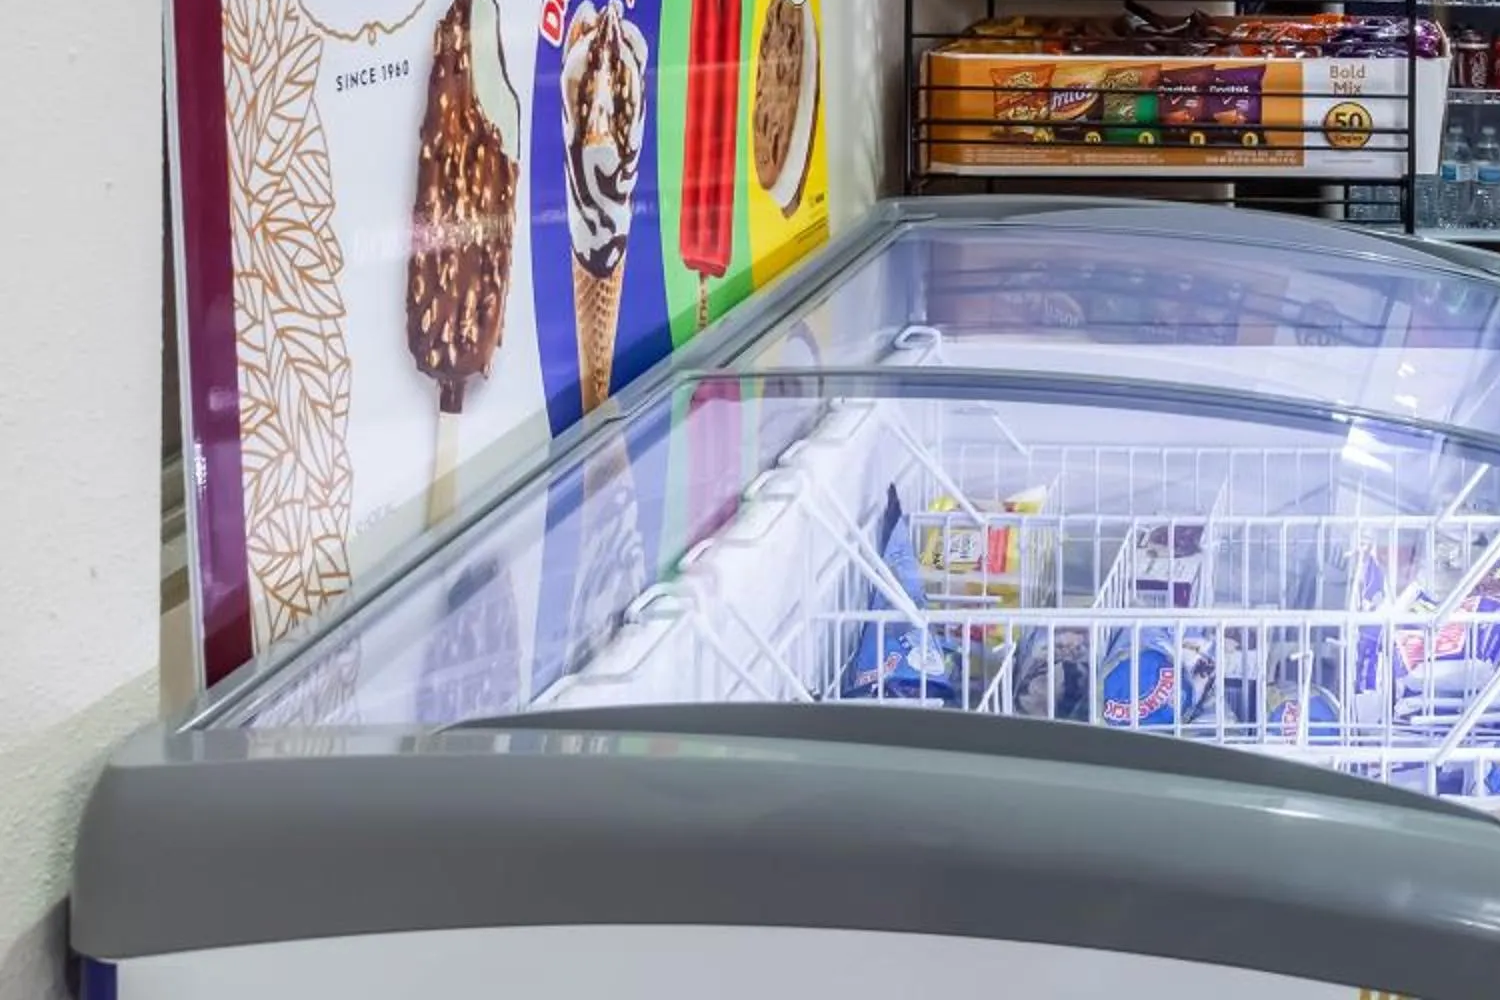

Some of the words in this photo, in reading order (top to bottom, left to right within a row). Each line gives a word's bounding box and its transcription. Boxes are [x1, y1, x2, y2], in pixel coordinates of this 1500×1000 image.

[336, 67, 377, 92] SINCE
[381, 60, 410, 83] 1960
[1329, 65, 1366, 79] Bold
[1333, 82, 1362, 96] Mix
[1335, 113, 1364, 130] 50
